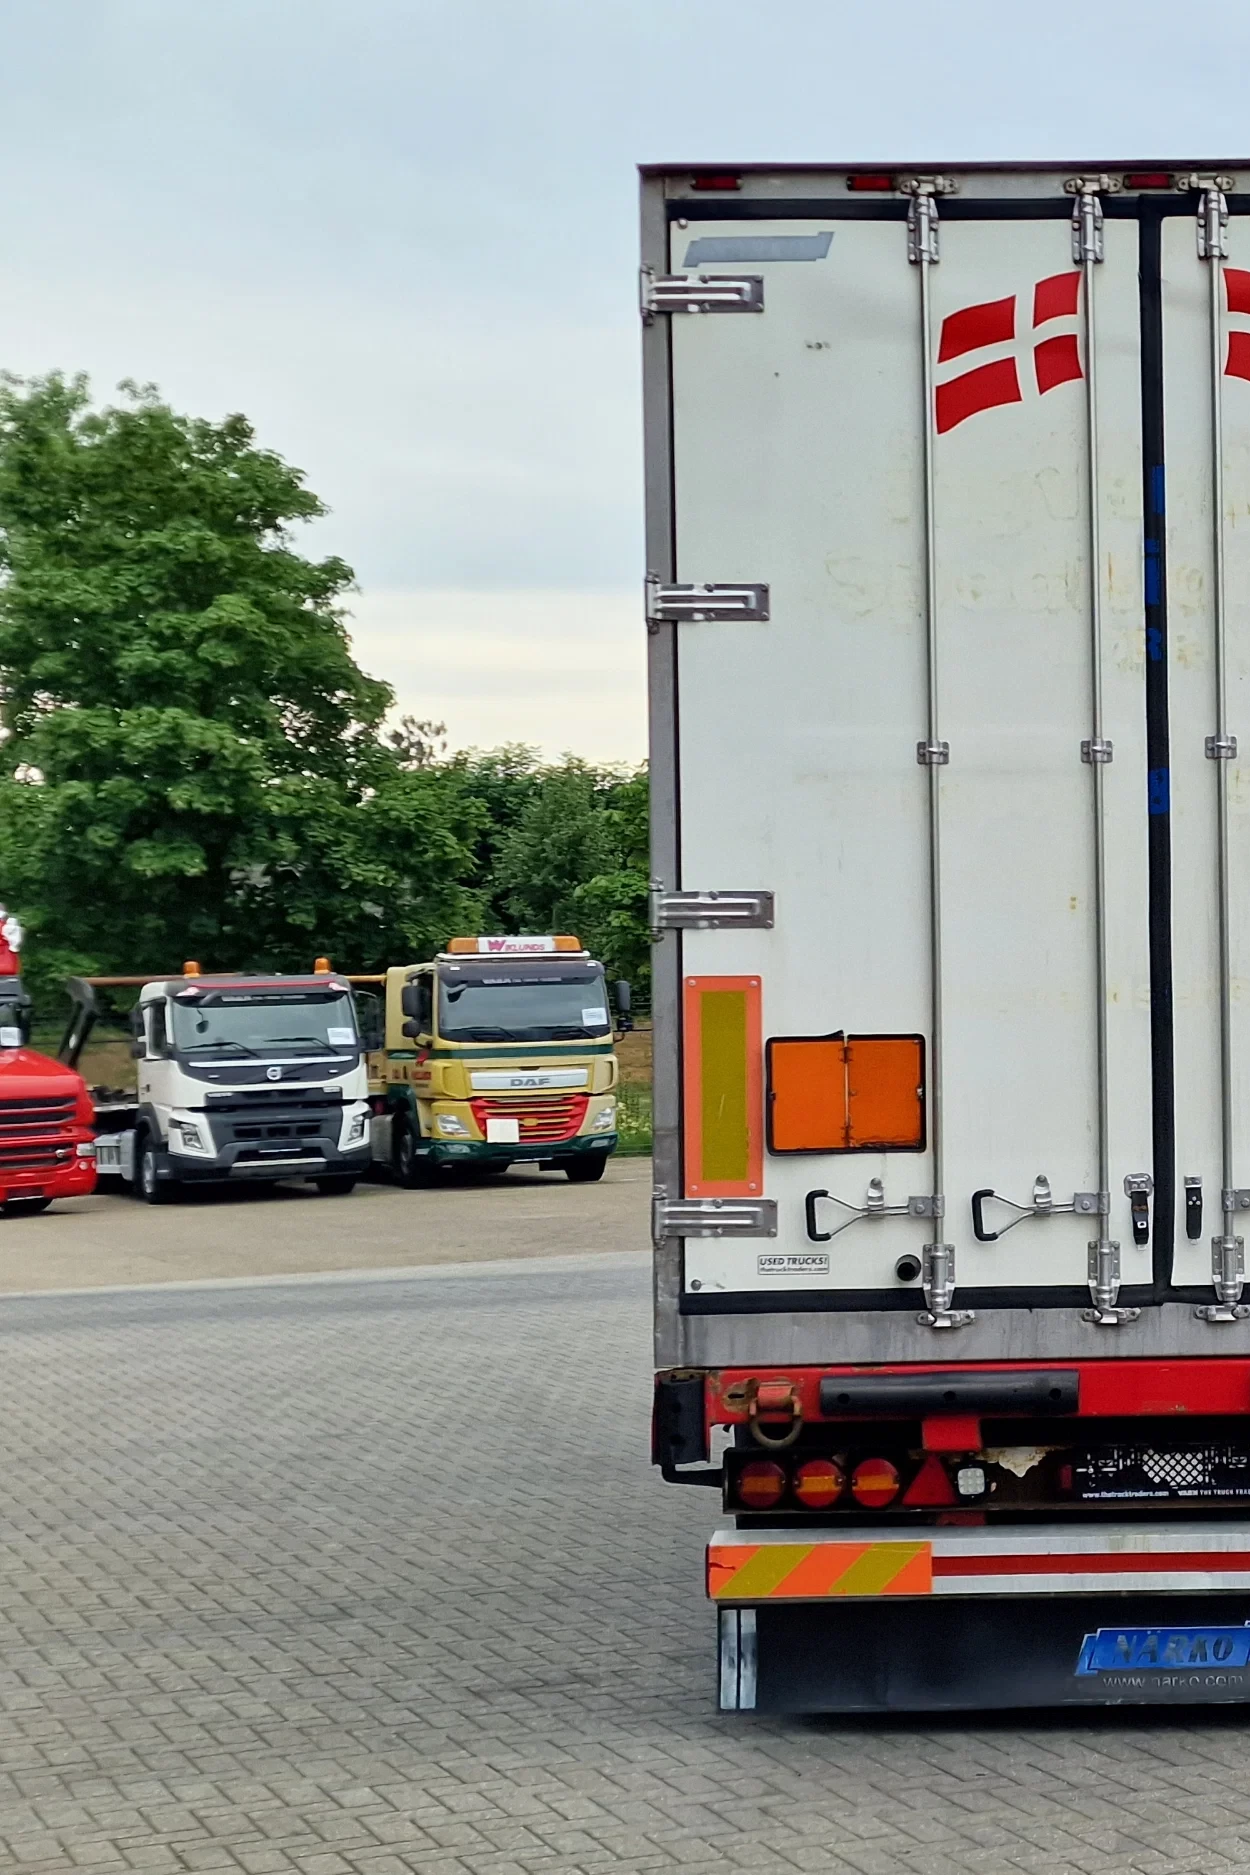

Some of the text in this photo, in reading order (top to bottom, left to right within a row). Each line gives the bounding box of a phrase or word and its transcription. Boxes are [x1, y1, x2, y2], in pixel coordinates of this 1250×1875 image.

[510, 1078, 550, 1087] DAF
[760, 1257, 828, 1266] USED TRUCKS!
